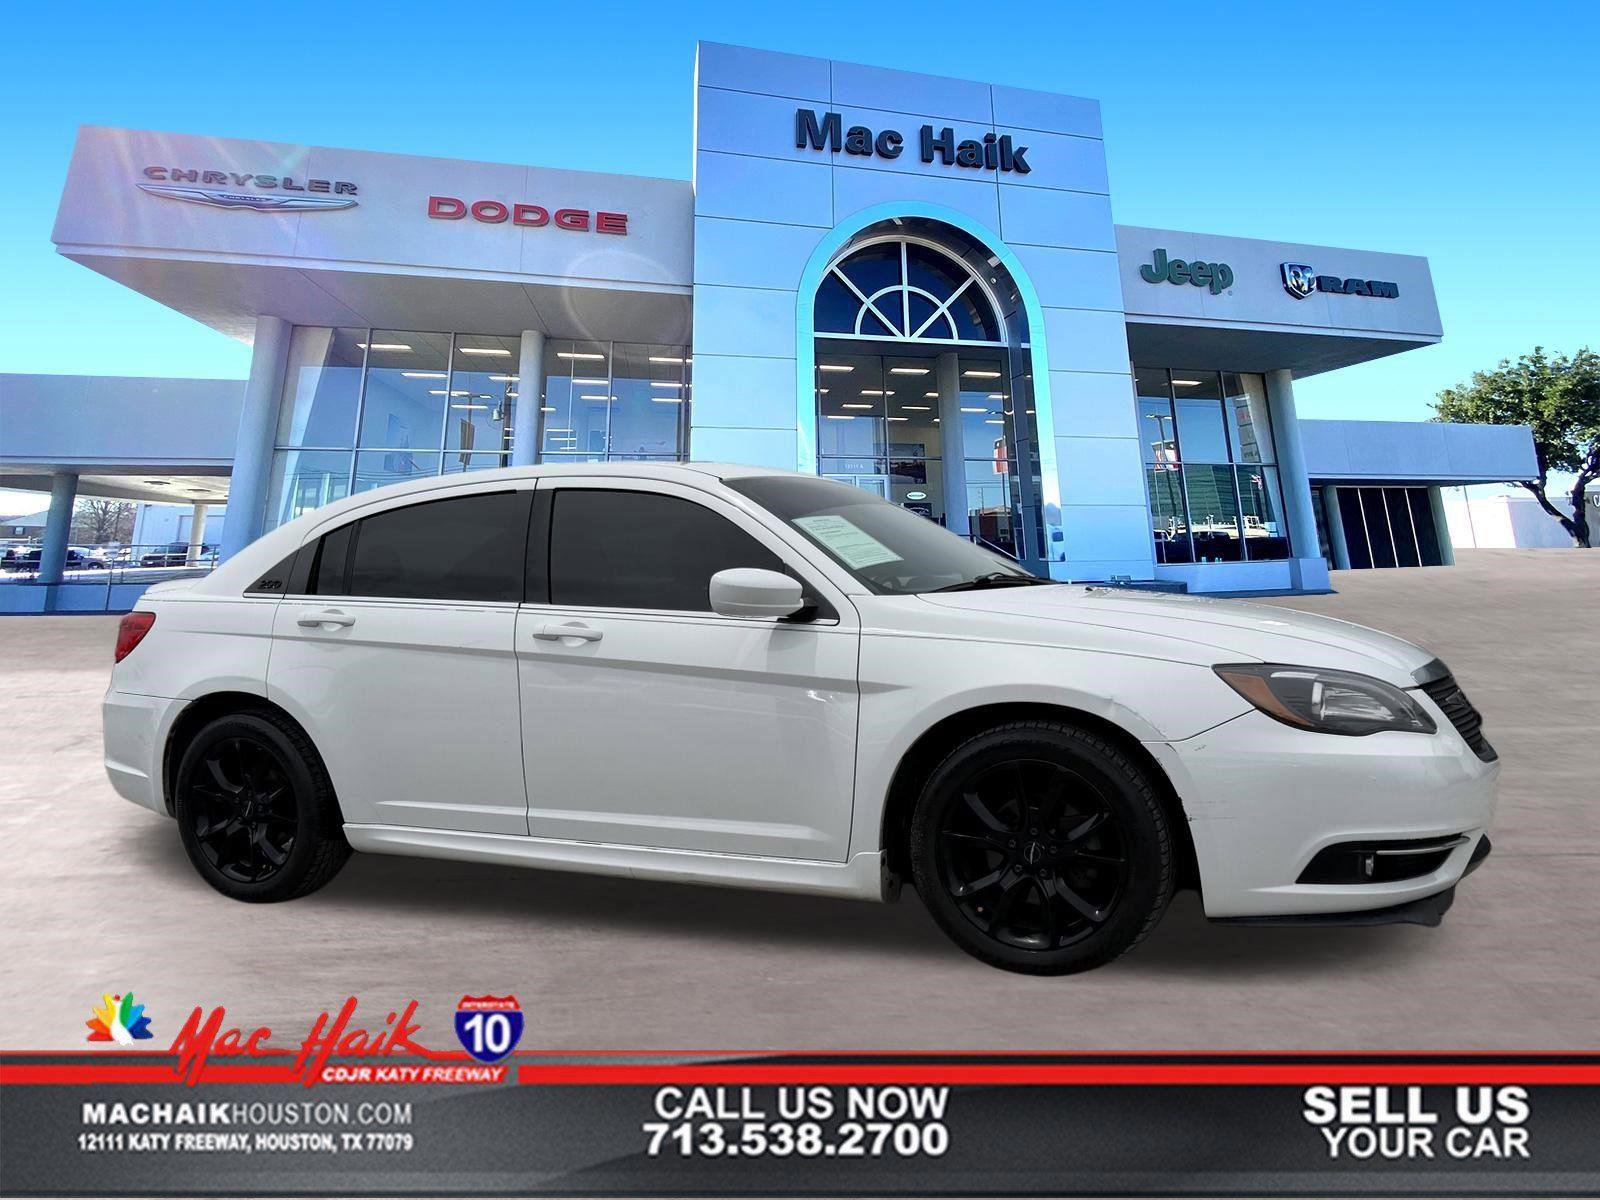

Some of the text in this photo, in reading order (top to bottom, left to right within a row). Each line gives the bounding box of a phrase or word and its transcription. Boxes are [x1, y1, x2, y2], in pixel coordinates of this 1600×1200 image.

[796, 108, 1032, 174] Mac Haik
[143, 166, 358, 196] CHRYSLER
[428, 196, 628, 236] DODGE
[1139, 248, 1234, 295] Jeep
[1315, 275, 1400, 299] RAM
